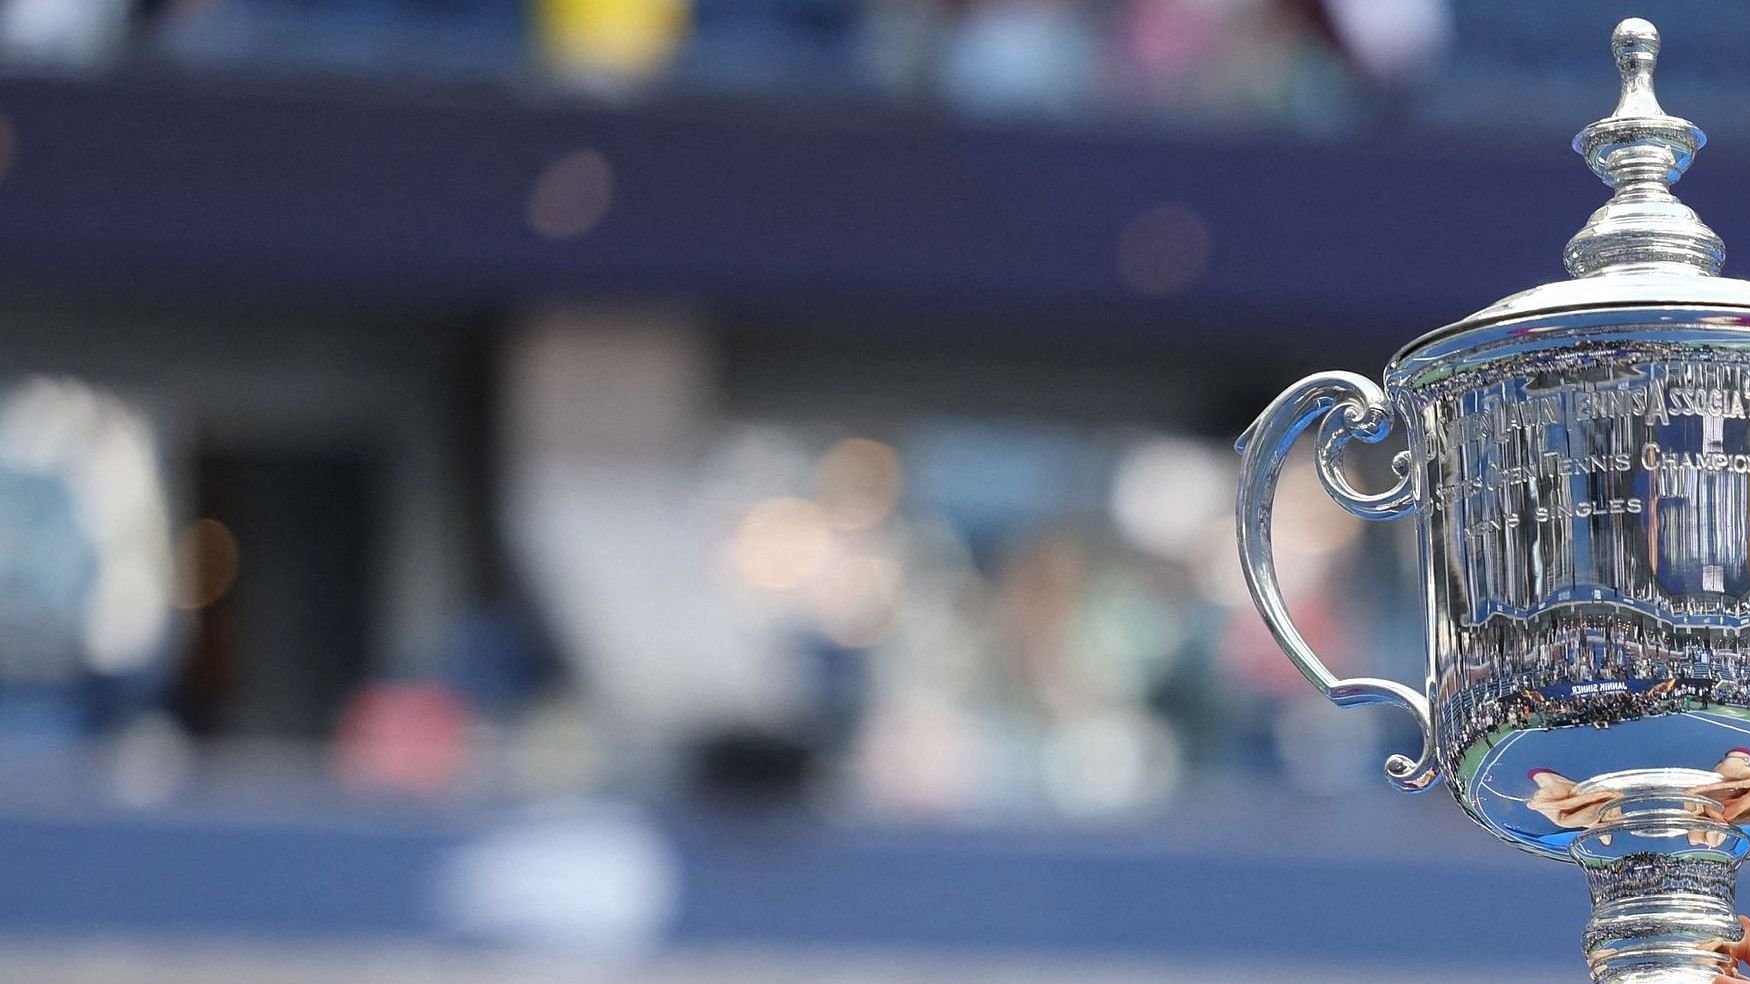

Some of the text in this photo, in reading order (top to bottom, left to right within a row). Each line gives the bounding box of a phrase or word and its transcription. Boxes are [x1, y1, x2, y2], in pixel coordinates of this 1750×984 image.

[1558, 386, 1647, 433] TENNIS
[1543, 452, 1632, 480] TENNIS
[1535, 498, 1642, 523] SINGLES
